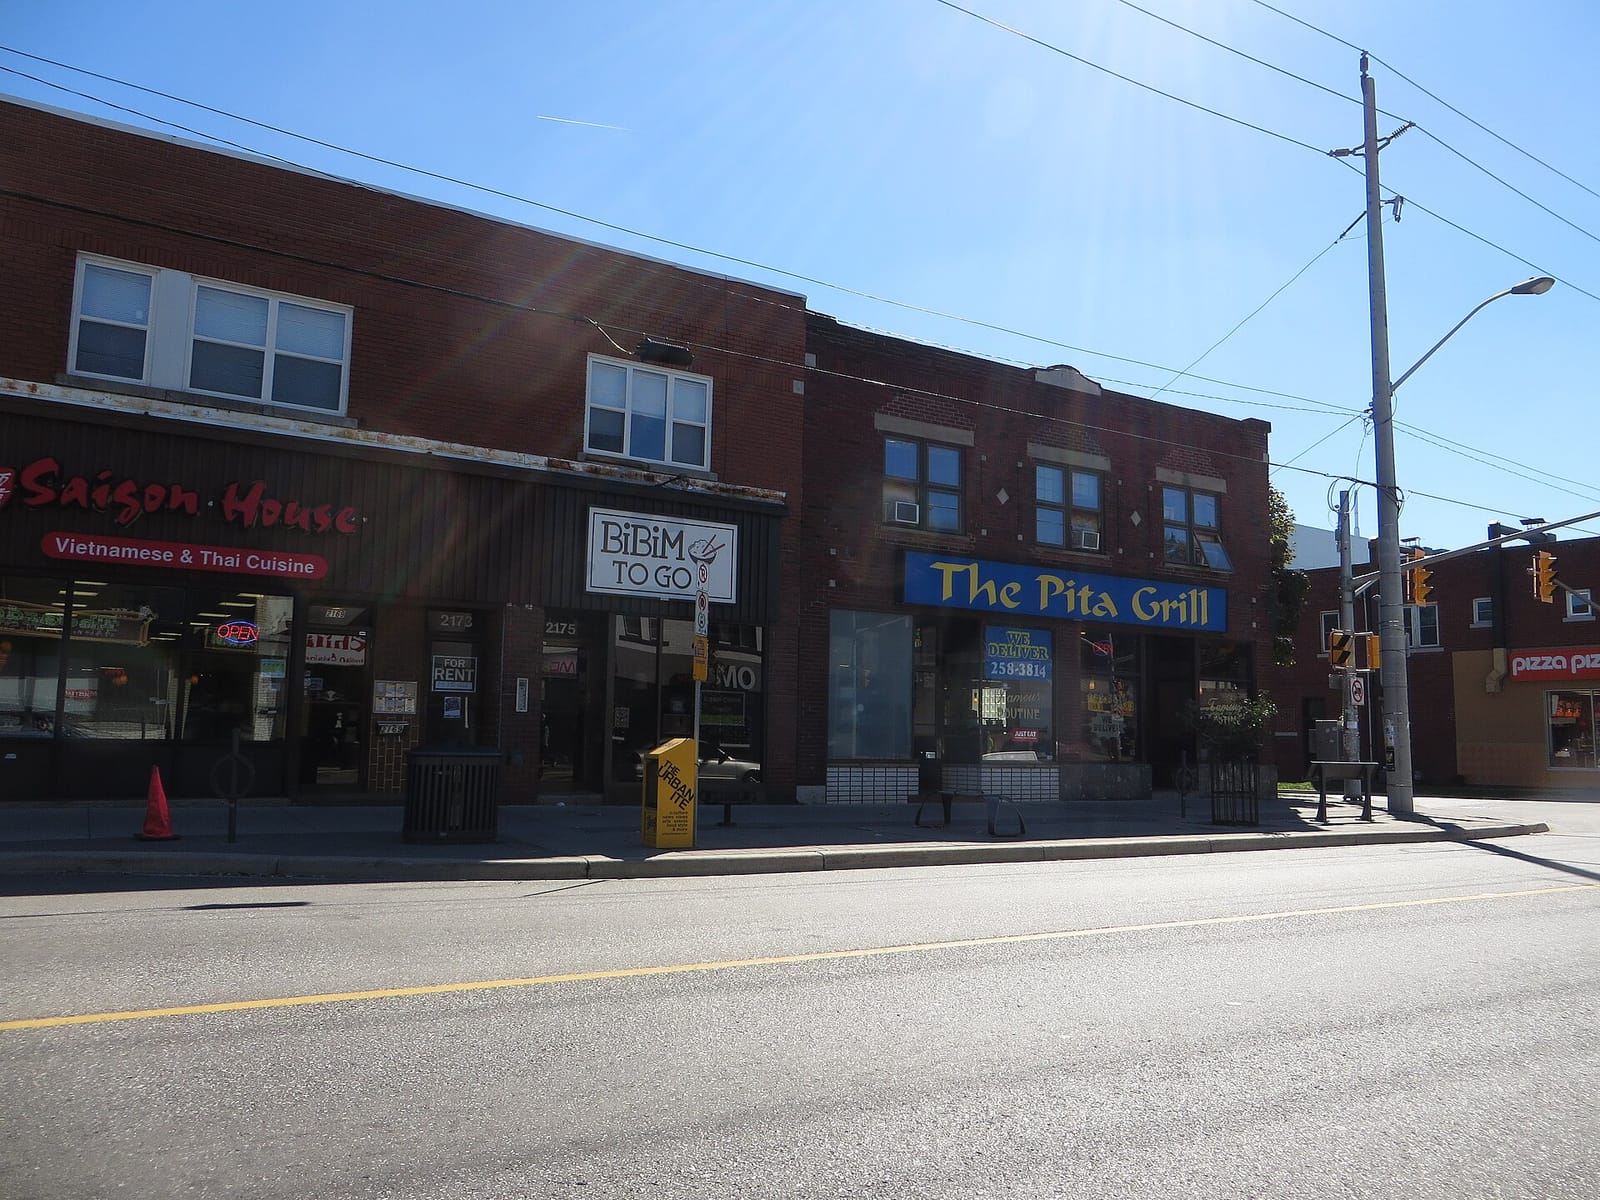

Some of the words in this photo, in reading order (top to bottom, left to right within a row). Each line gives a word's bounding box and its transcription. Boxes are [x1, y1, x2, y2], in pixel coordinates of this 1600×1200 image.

[21, 457, 199, 525] Saigon
[222, 480, 360, 534] House
[56, 537, 174, 563] Vietnamese
[180, 549, 193, 564] &
[200, 550, 241, 569] Thai
[247, 554, 315, 574] Cuisine
[612, 560, 649, 585] TO
[654, 565, 692, 590] GO
[929, 561, 1022, 609] The
[1035, 574, 1119, 618] Pita
[1131, 586, 1209, 627] Grill
[217, 624, 261, 641] OPEN
[545, 621, 576, 635] 2175
[1005, 630, 1030, 645] WE
[987, 642, 1049, 660] DELIVER
[444, 658, 466, 668] FOR
[990, 661, 1047, 679] 258-3814
[434, 667, 474, 681] RENT
[663, 760, 681, 777] THE
[658, 766, 694, 802] URBAN
[670, 791, 690, 811] ITE
